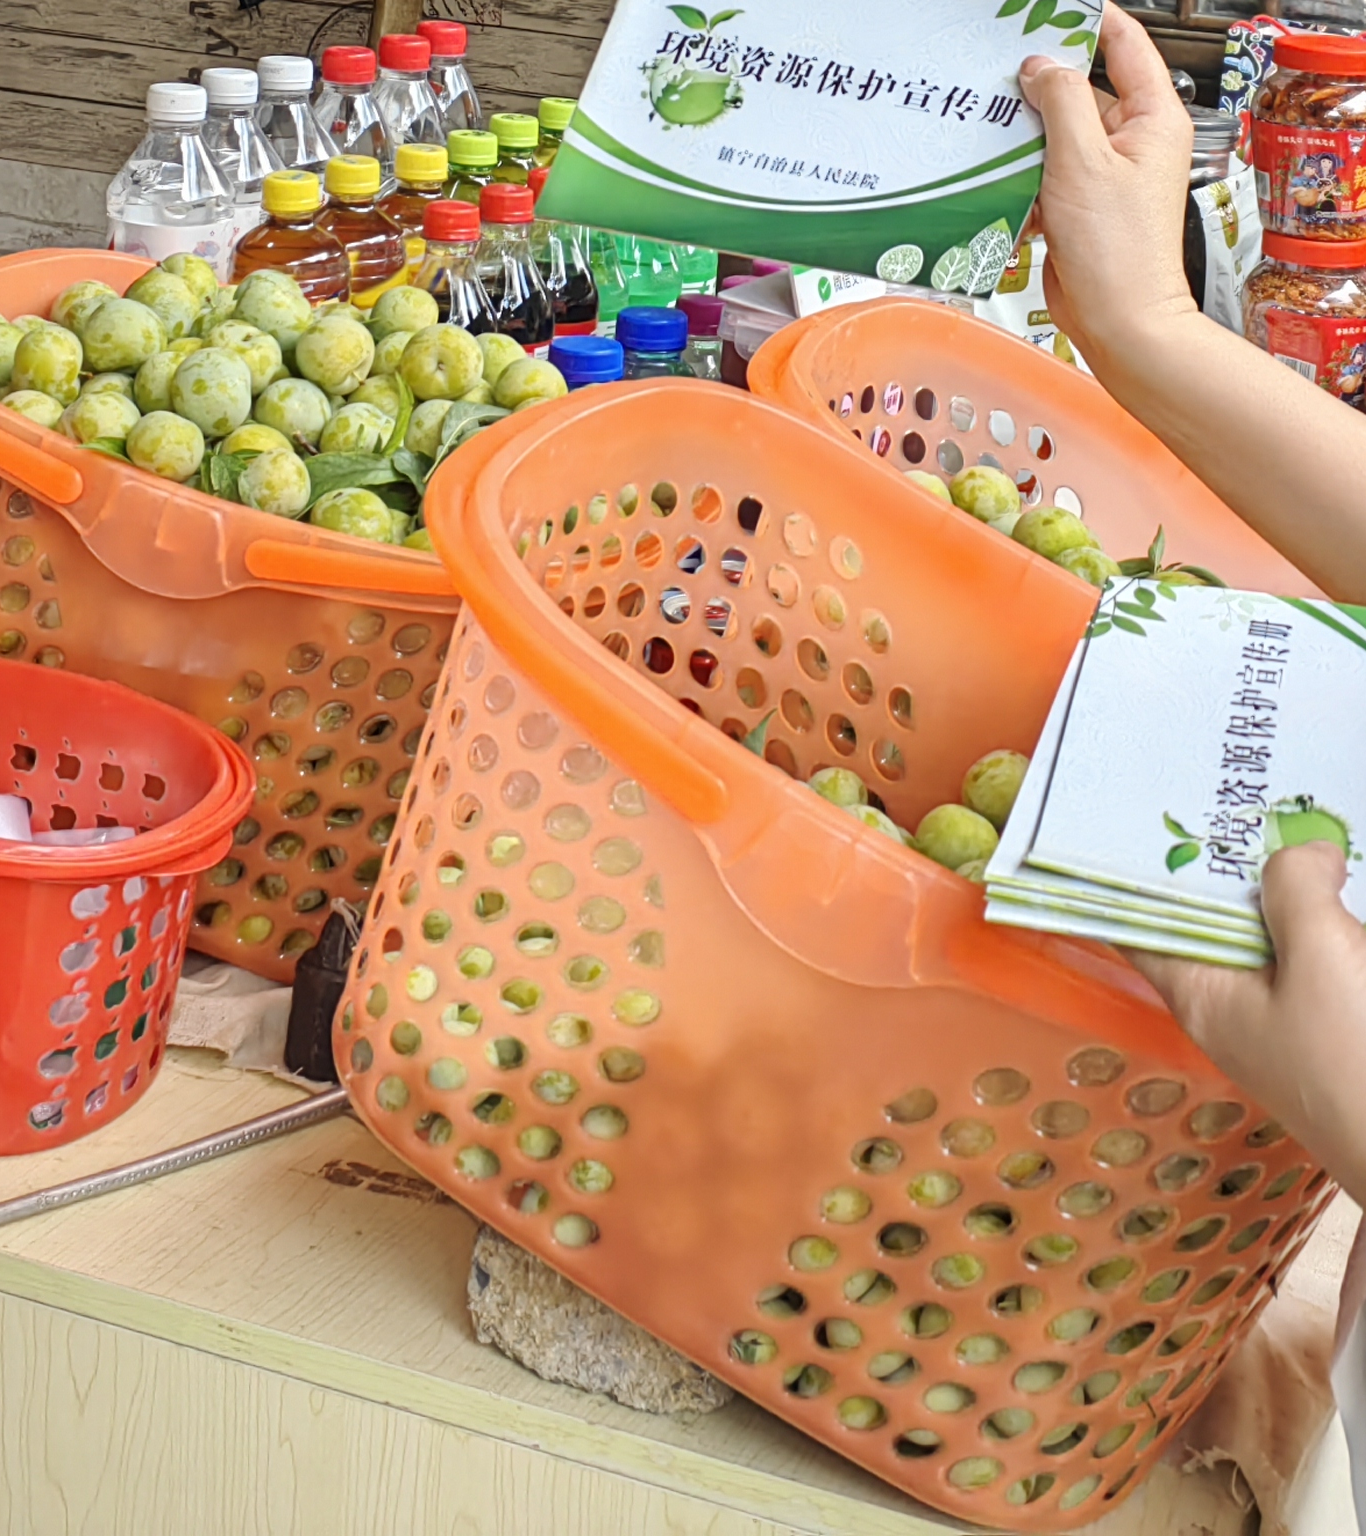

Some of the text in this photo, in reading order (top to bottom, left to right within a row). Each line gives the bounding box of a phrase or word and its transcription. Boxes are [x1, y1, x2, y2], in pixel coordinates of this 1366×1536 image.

[655, 28, 1024, 128] 环境资源保护宣传册
[717, 145, 881, 191] 镇宁自治县人民法院
[1206, 618, 1294, 881] 环境资源保护宣传册
